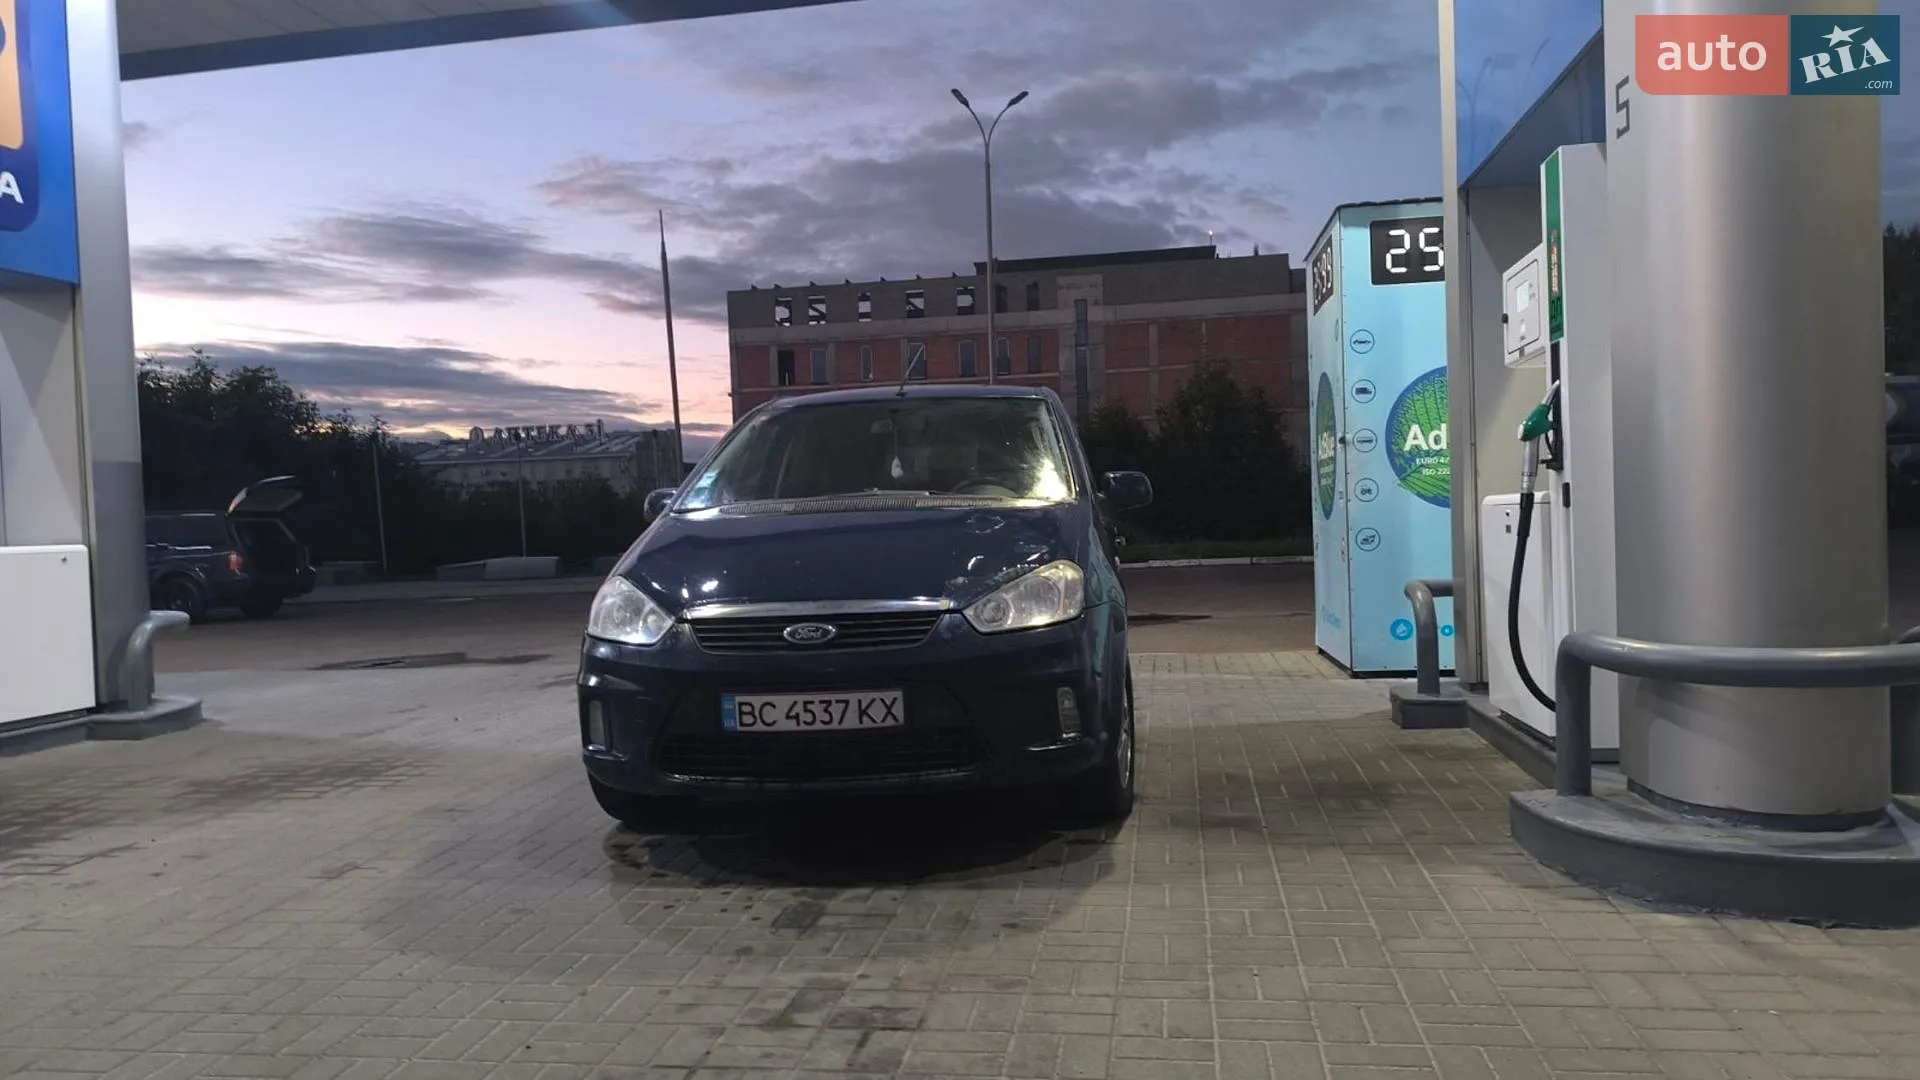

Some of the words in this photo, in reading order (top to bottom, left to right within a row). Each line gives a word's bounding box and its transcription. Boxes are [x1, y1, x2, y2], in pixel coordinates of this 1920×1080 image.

[795, 627, 823, 639] Ford
[737, 701, 777, 728] BC
[785, 699, 850, 727] 4537
[858, 696, 898, 725] KX
